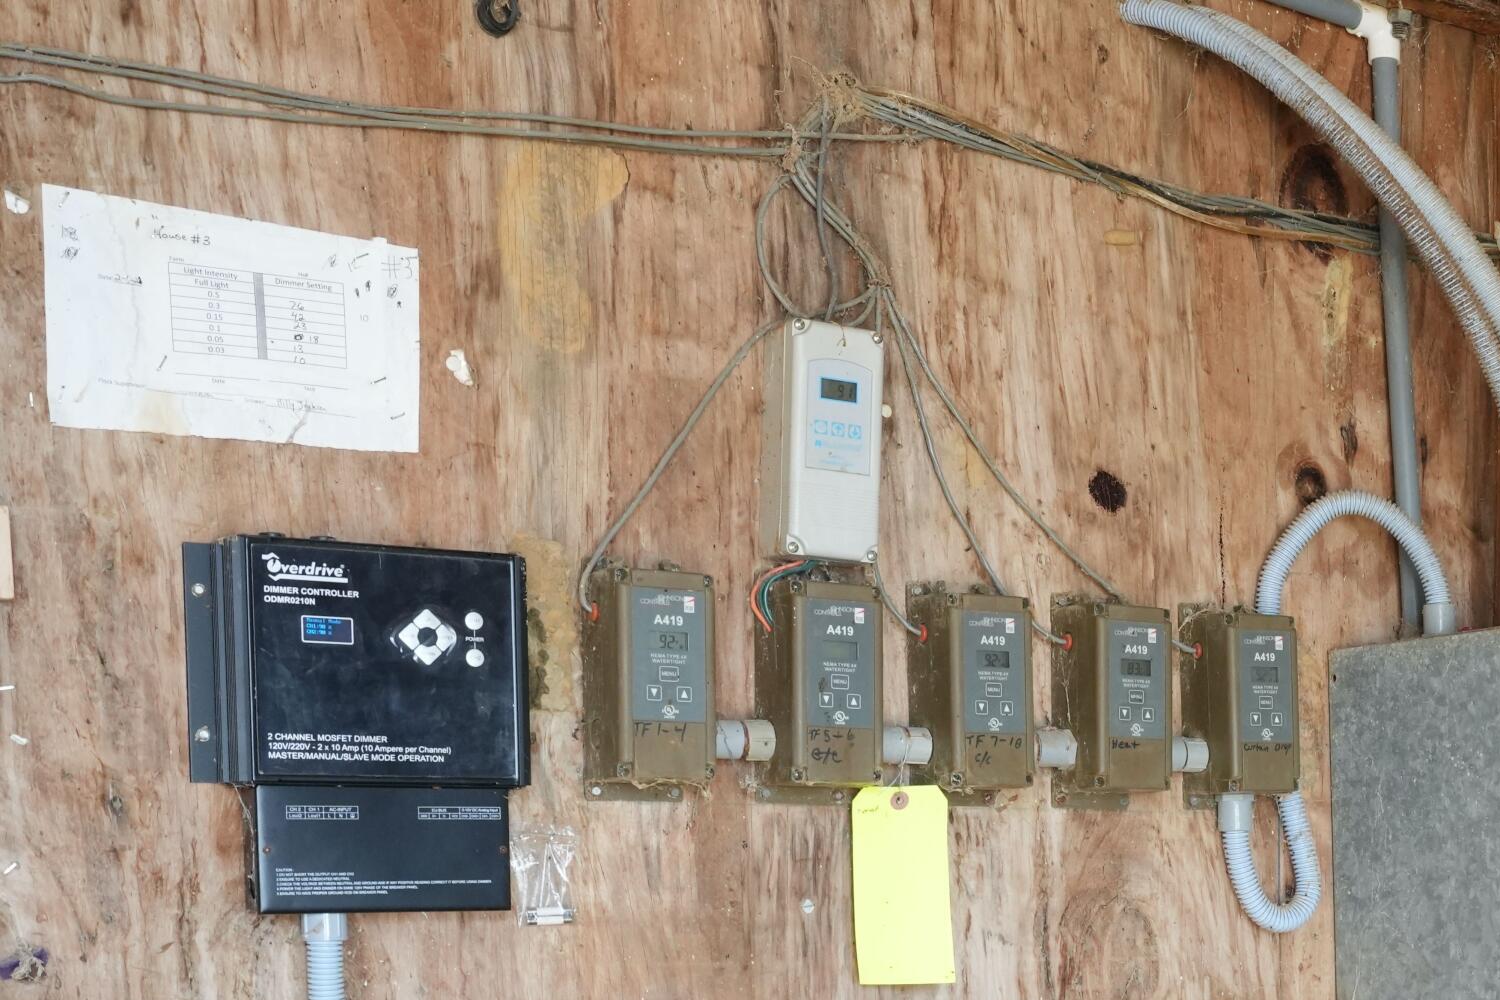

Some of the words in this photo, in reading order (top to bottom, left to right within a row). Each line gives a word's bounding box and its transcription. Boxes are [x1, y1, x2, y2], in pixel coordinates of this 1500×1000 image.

[183, 266, 203, 276] Light
[204, 268, 238, 281] Intensity
[194, 275, 208, 286] Full
[210, 279, 229, 289] Light
[275, 277, 304, 287] Dimmer
[306, 281, 333, 293] Setting
[207, 291, 220, 299] 0.5
[208, 302, 220, 310] 0.3
[206, 312, 223, 321] 0.15
[209, 324, 221, 332] 0.1
[207, 335, 224, 343] 0.05
[266, 559, 344, 577] Overdrive
[263, 585, 299, 595] DIMMER
[300, 587, 359, 599] CONTROLLER
[263, 595, 316, 606] ODMR0210N
[654, 615, 683, 626] A419
[827, 625, 854, 636] A419
[981, 635, 1006, 645] A419
[1125, 645, 1148, 654] A419
[1254, 653, 1276, 661] A419
[275, 733, 316, 742] CHANNEL
[317, 734, 352, 742] MOSFET
[354, 735, 388, 743] DIMMER
[268, 742, 311, 750] 120V/220V
[342, 744, 359, 753] Amp
[361, 744, 373, 754] (10
[375, 745, 403, 754] Ampere
[405, 747, 417, 755] per
[418, 746, 452, 755] Channel)
[268, 752, 369, 761] MASTER/MANUAL/SLAVE
[371, 754, 396, 762] MODE
[398, 754, 445, 762] OPERATION
